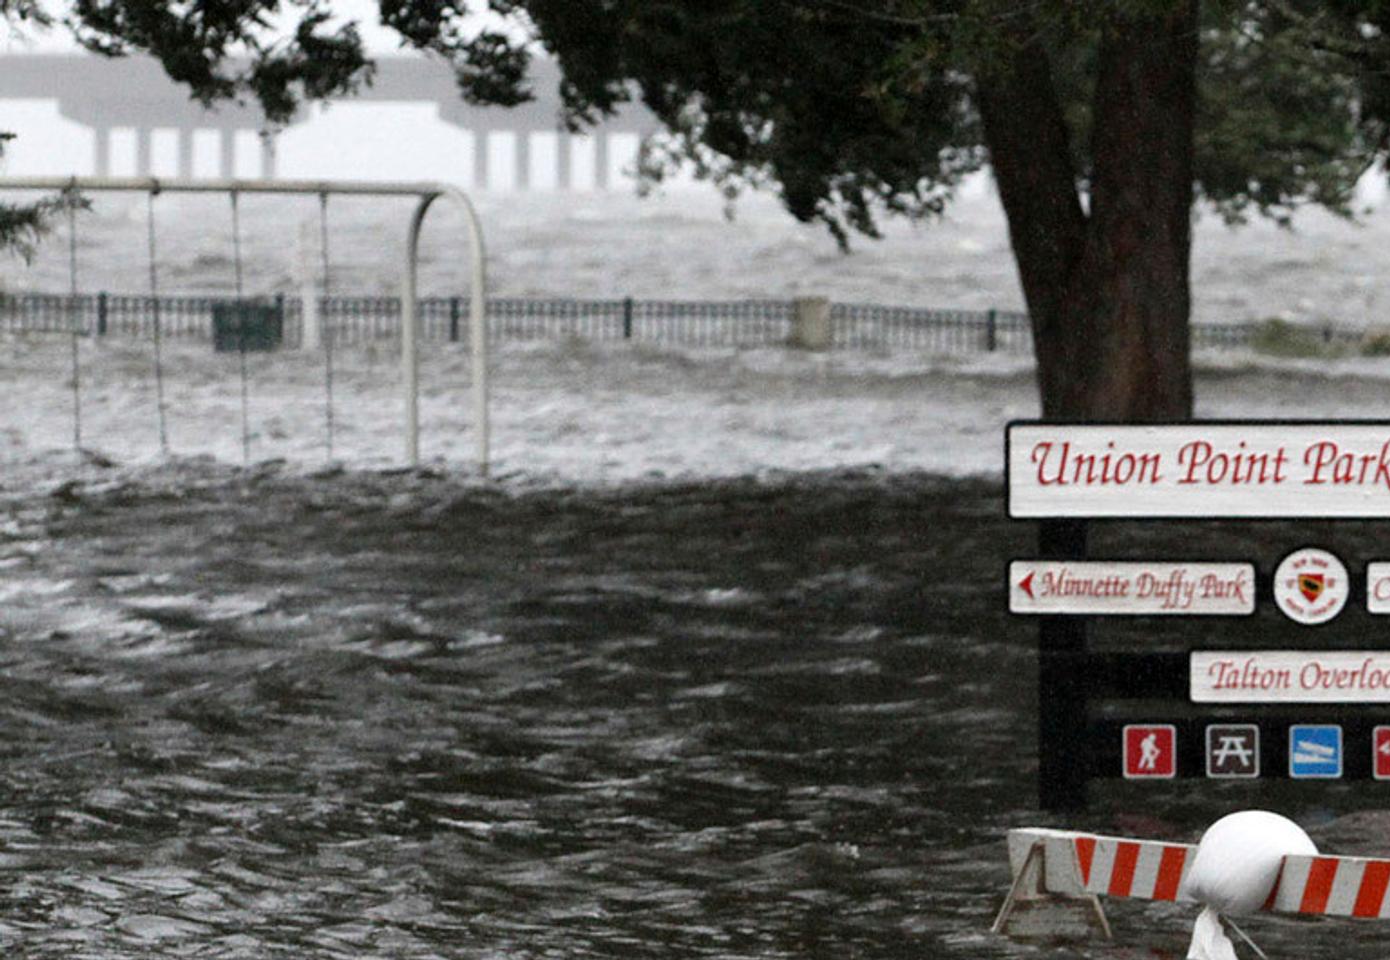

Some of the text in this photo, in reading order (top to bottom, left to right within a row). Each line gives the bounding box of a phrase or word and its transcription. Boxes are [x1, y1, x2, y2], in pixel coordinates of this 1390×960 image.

[1030, 441, 1162, 486] Union
[1178, 441, 1287, 485] Point
[1040, 567, 1248, 610] Minnette Duffy Park
[1208, 658, 1291, 690] Talton
